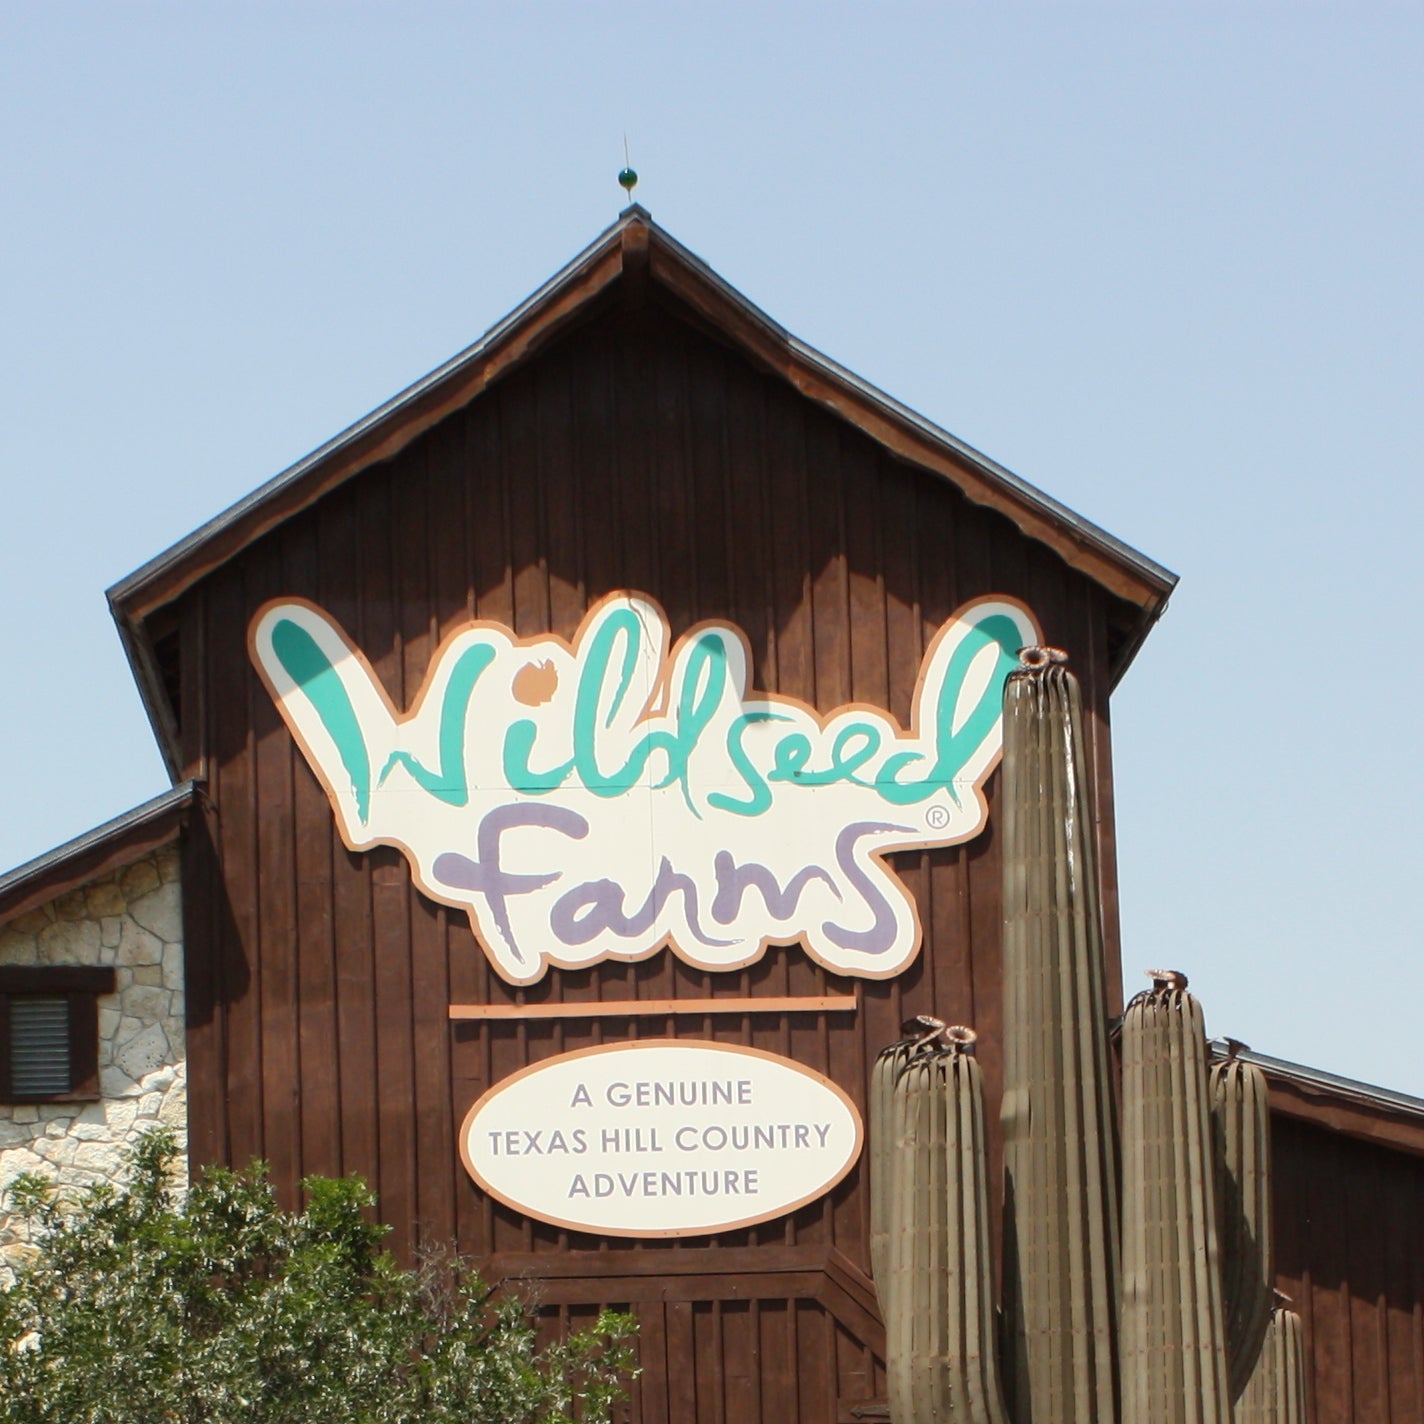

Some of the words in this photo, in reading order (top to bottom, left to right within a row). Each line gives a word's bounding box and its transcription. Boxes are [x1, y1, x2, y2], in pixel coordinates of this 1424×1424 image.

[272, 608, 1022, 826] Wildseed
[432, 802, 919, 964] Farms
[570, 1083, 594, 1109] A
[605, 1080, 753, 1107] GENUINE
[487, 1129, 588, 1156] TEXAS
[600, 1127, 664, 1154] HILL
[674, 1124, 832, 1151] COUNTRY
[568, 1170, 759, 1198] ADVENTURE
